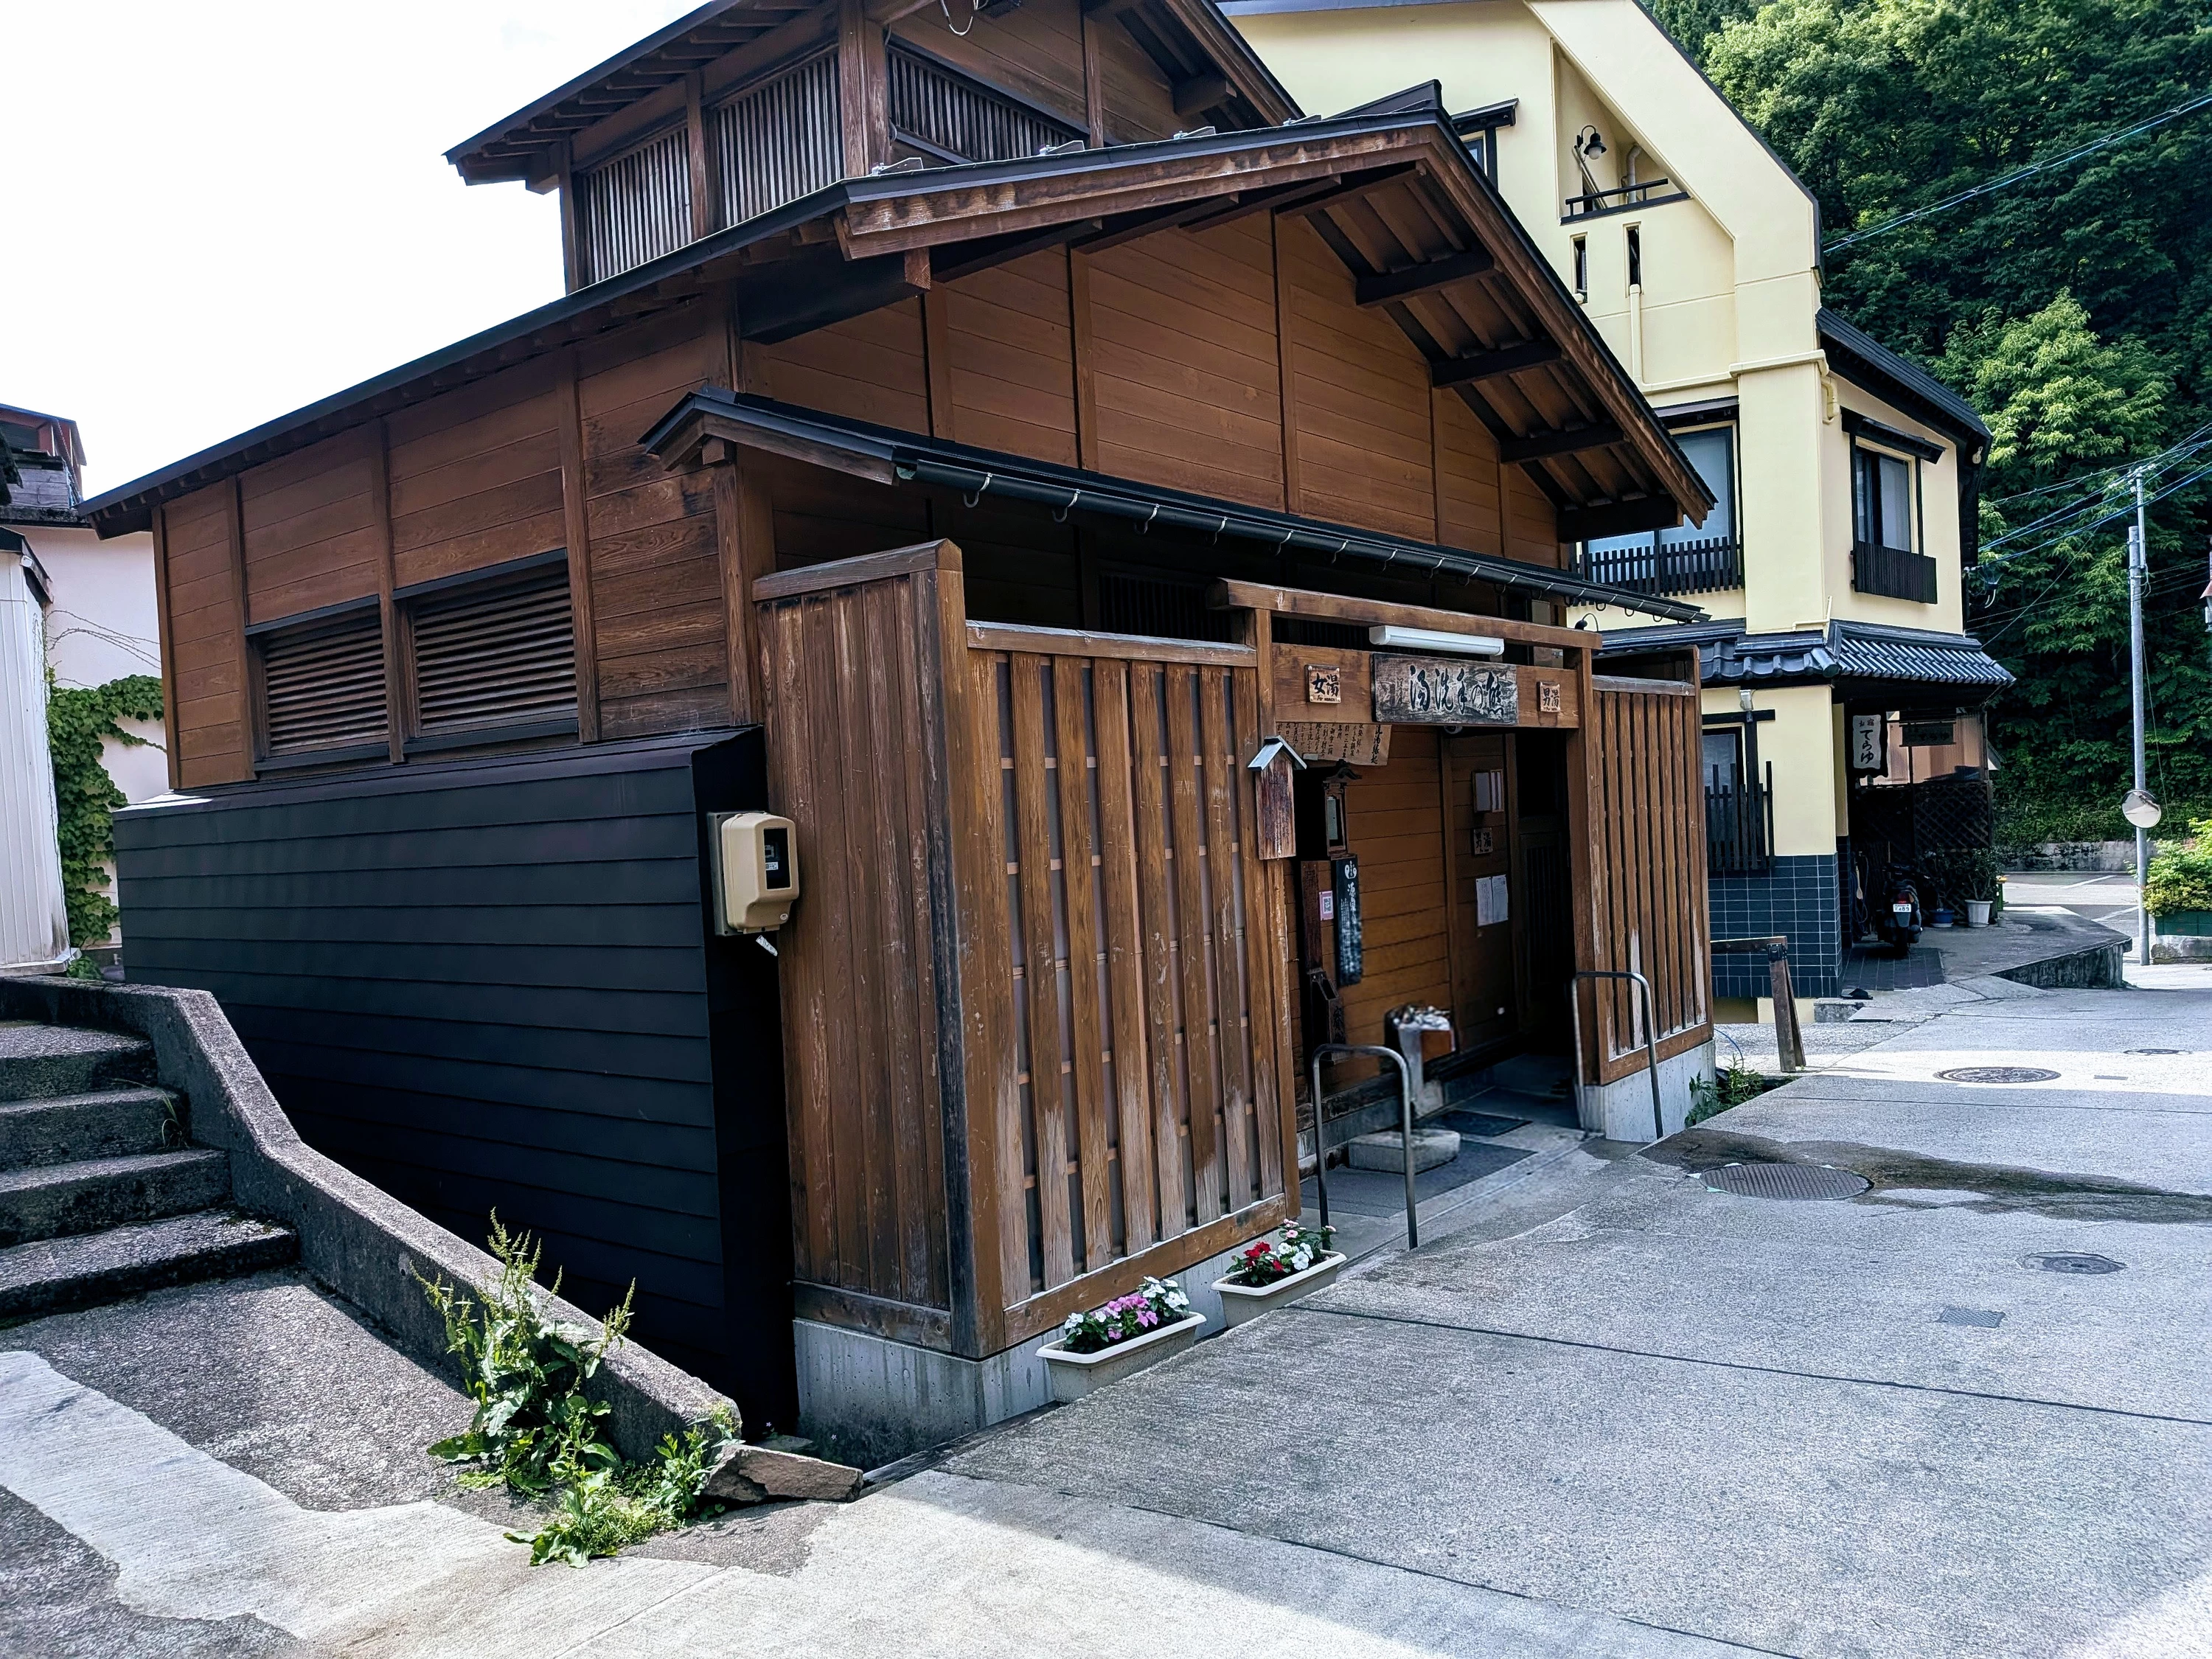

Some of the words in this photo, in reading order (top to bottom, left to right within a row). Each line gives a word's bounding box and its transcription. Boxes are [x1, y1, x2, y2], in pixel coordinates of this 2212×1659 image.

[1311, 672, 1339, 697] 女湯
[1543, 687, 1560, 708] 男湯
[1860, 729, 1875, 765] てらゆ
[1475, 832, 1492, 849] 男湯
